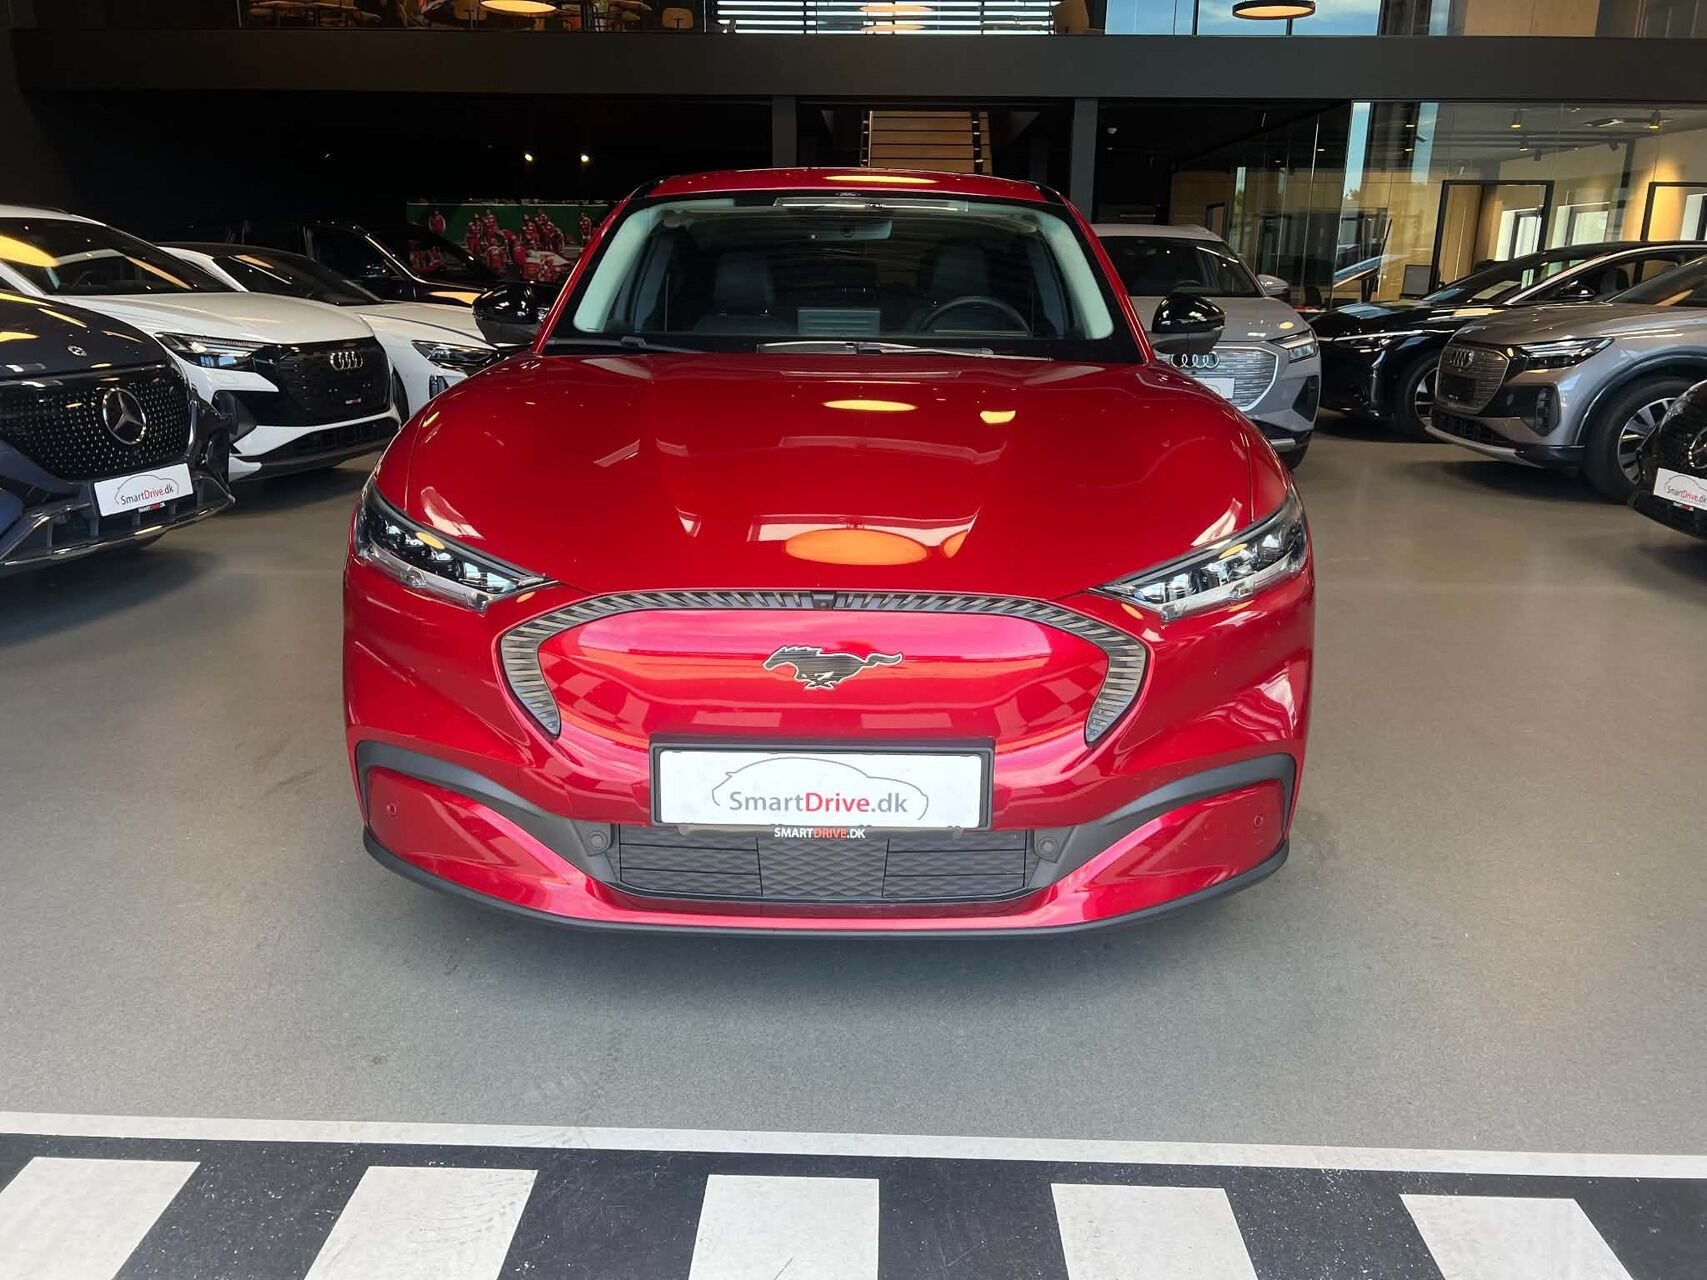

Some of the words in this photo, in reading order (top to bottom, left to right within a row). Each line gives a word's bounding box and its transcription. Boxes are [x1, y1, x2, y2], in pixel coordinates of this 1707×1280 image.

[120, 484, 174, 505] SmartDrive.dk
[729, 791, 908, 813] SmartDrive.dk
[774, 827, 866, 839] SMARTDRIVE.DK
